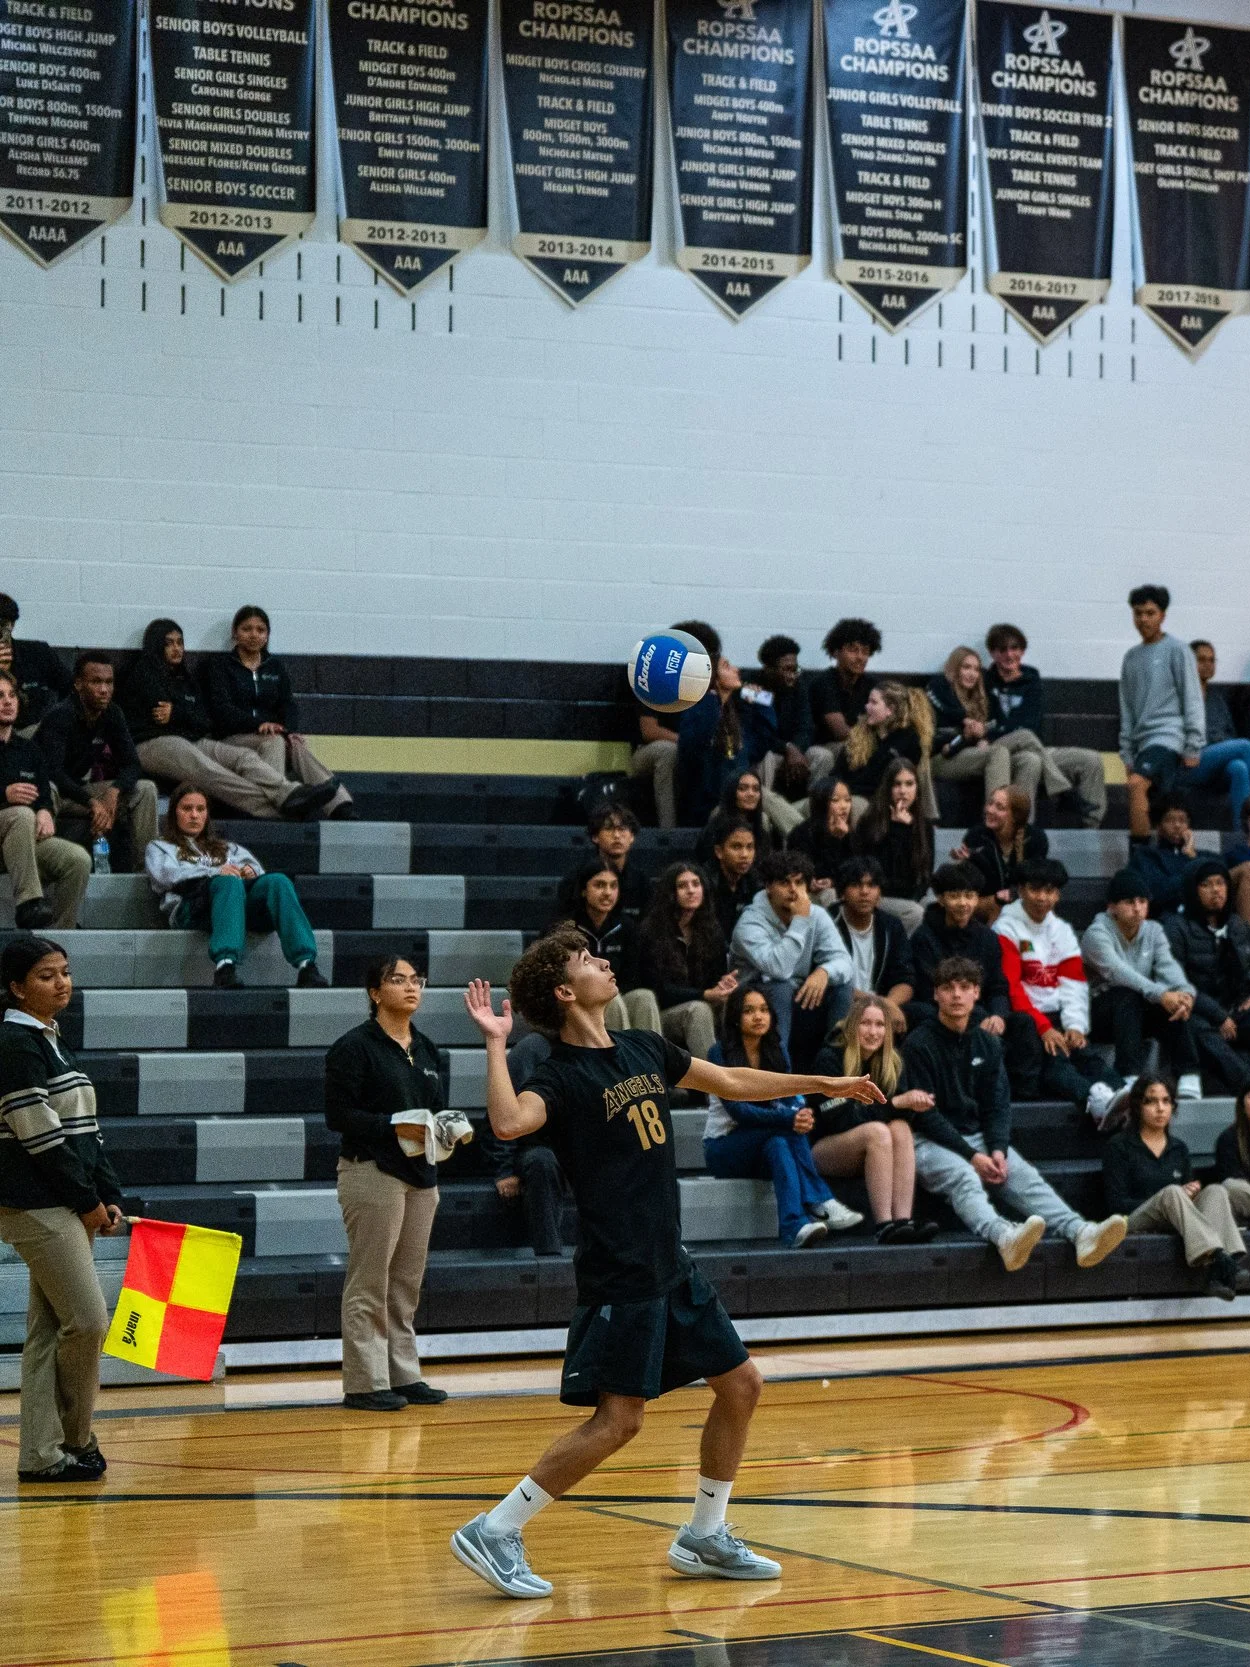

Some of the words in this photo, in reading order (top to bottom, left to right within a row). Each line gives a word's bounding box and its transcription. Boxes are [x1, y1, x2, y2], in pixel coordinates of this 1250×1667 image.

[8, 1, 45, 17] TRACK
[48, 7, 57, 18] &
[60, 7, 92, 22] FIELD
[347, 1, 469, 31] CHAMPIONS
[533, 1, 622, 26] ROPSSAA
[25, 25, 52, 39] BOYS
[55, 28, 82, 42] HIGH
[85, 32, 116, 45] JUMP
[156, 15, 199, 33] SENIOR
[203, 21, 234, 37] BOYS
[236, 25, 308, 44] VOLLEYBALL
[519, 20, 635, 48] CHAMPIONS
[697, 19, 782, 45] ROPSSAA
[192, 46, 228, 62] TABLE
[230, 50, 271, 67] TENNIS
[367, 39, 406, 55] TRACK
[408, 45, 416, 56] &
[418, 44, 448, 59] FIELD
[683, 38, 795, 65] CHAMPIONS
[854, 36, 936, 61] ROPSSAA
[39, 63, 66, 77] BOYS
[69, 66, 100, 81] 400m
[359, 60, 398, 74] MIDGET
[400, 64, 425, 78] BOYS
[428, 67, 456, 81] 400m
[841, 55, 949, 82] CHAMPIONS
[1005, 52, 1085, 78] ROPSSAA
[174, 66, 213, 82] SENIOR
[215, 70, 245, 86] GIRLS
[247, 74, 288, 90] SINGLES
[702, 72, 736, 88] TRACK
[739, 76, 746, 89] &
[749, 78, 778, 93] FIELD
[991, 71, 1097, 98] CHAMPIONS
[1150, 69, 1228, 93] ROPSSAA
[191, 83, 235, 99] CAROLINE
[237, 88, 272, 102] GEORGE
[1138, 86, 1239, 112] CHAMPIONS
[17, 97, 44, 112] BOYS
[171, 102, 210, 117] SENIOR
[213, 106, 242, 120] GIRLS
[244, 109, 291, 125] DOUBLES
[344, 94, 382, 108] JUNIOR
[384, 98, 414, 111] GIRLS
[416, 101, 440, 113] HIGH
[442, 104, 471, 117] JUMP
[538, 95, 572, 110] TRACK
[576, 99, 584, 111] &
[586, 100, 616, 115] FIELD
[169, 137, 208, 150] SENIOR
[210, 141, 243, 155] MIXED
[246, 144, 292, 160] DOUBLES
[358, 165, 395, 178] SENIOR
[398, 168, 425, 181] GIRLS
[428, 172, 456, 185] 400m
[858, 171, 891, 187] TRACK
[893, 174, 901, 187] &
[903, 175, 930, 190] FIELD
[167, 176, 212, 193] SENIOR
[215, 180, 246, 196] BOYS
[249, 184, 295, 200] SOCCER
[6, 195, 90, 214] 2011-2012
[190, 211, 272, 229] 2012-2013
[28, 226, 66, 242] AAAA
[368, 226, 446, 244] 2012-2013
[217, 241, 245, 256] AAA
[538, 240, 614, 257] 2013-2014
[394, 256, 422, 271] AAA
[702, 254, 774, 271] 2014-2015
[563, 269, 589, 284] AAA
[859, 266, 929, 283] 2015-2016
[726, 282, 751, 296] AAA
[1010, 279, 1078, 295] 2016-2017
[882, 294, 906, 309] AAA
[1032, 305, 1057, 320] AAA
[638, 643, 657, 693] Baden
[603, 1074, 665, 1122] ANGELS
[626, 1100, 666, 1151] 18
